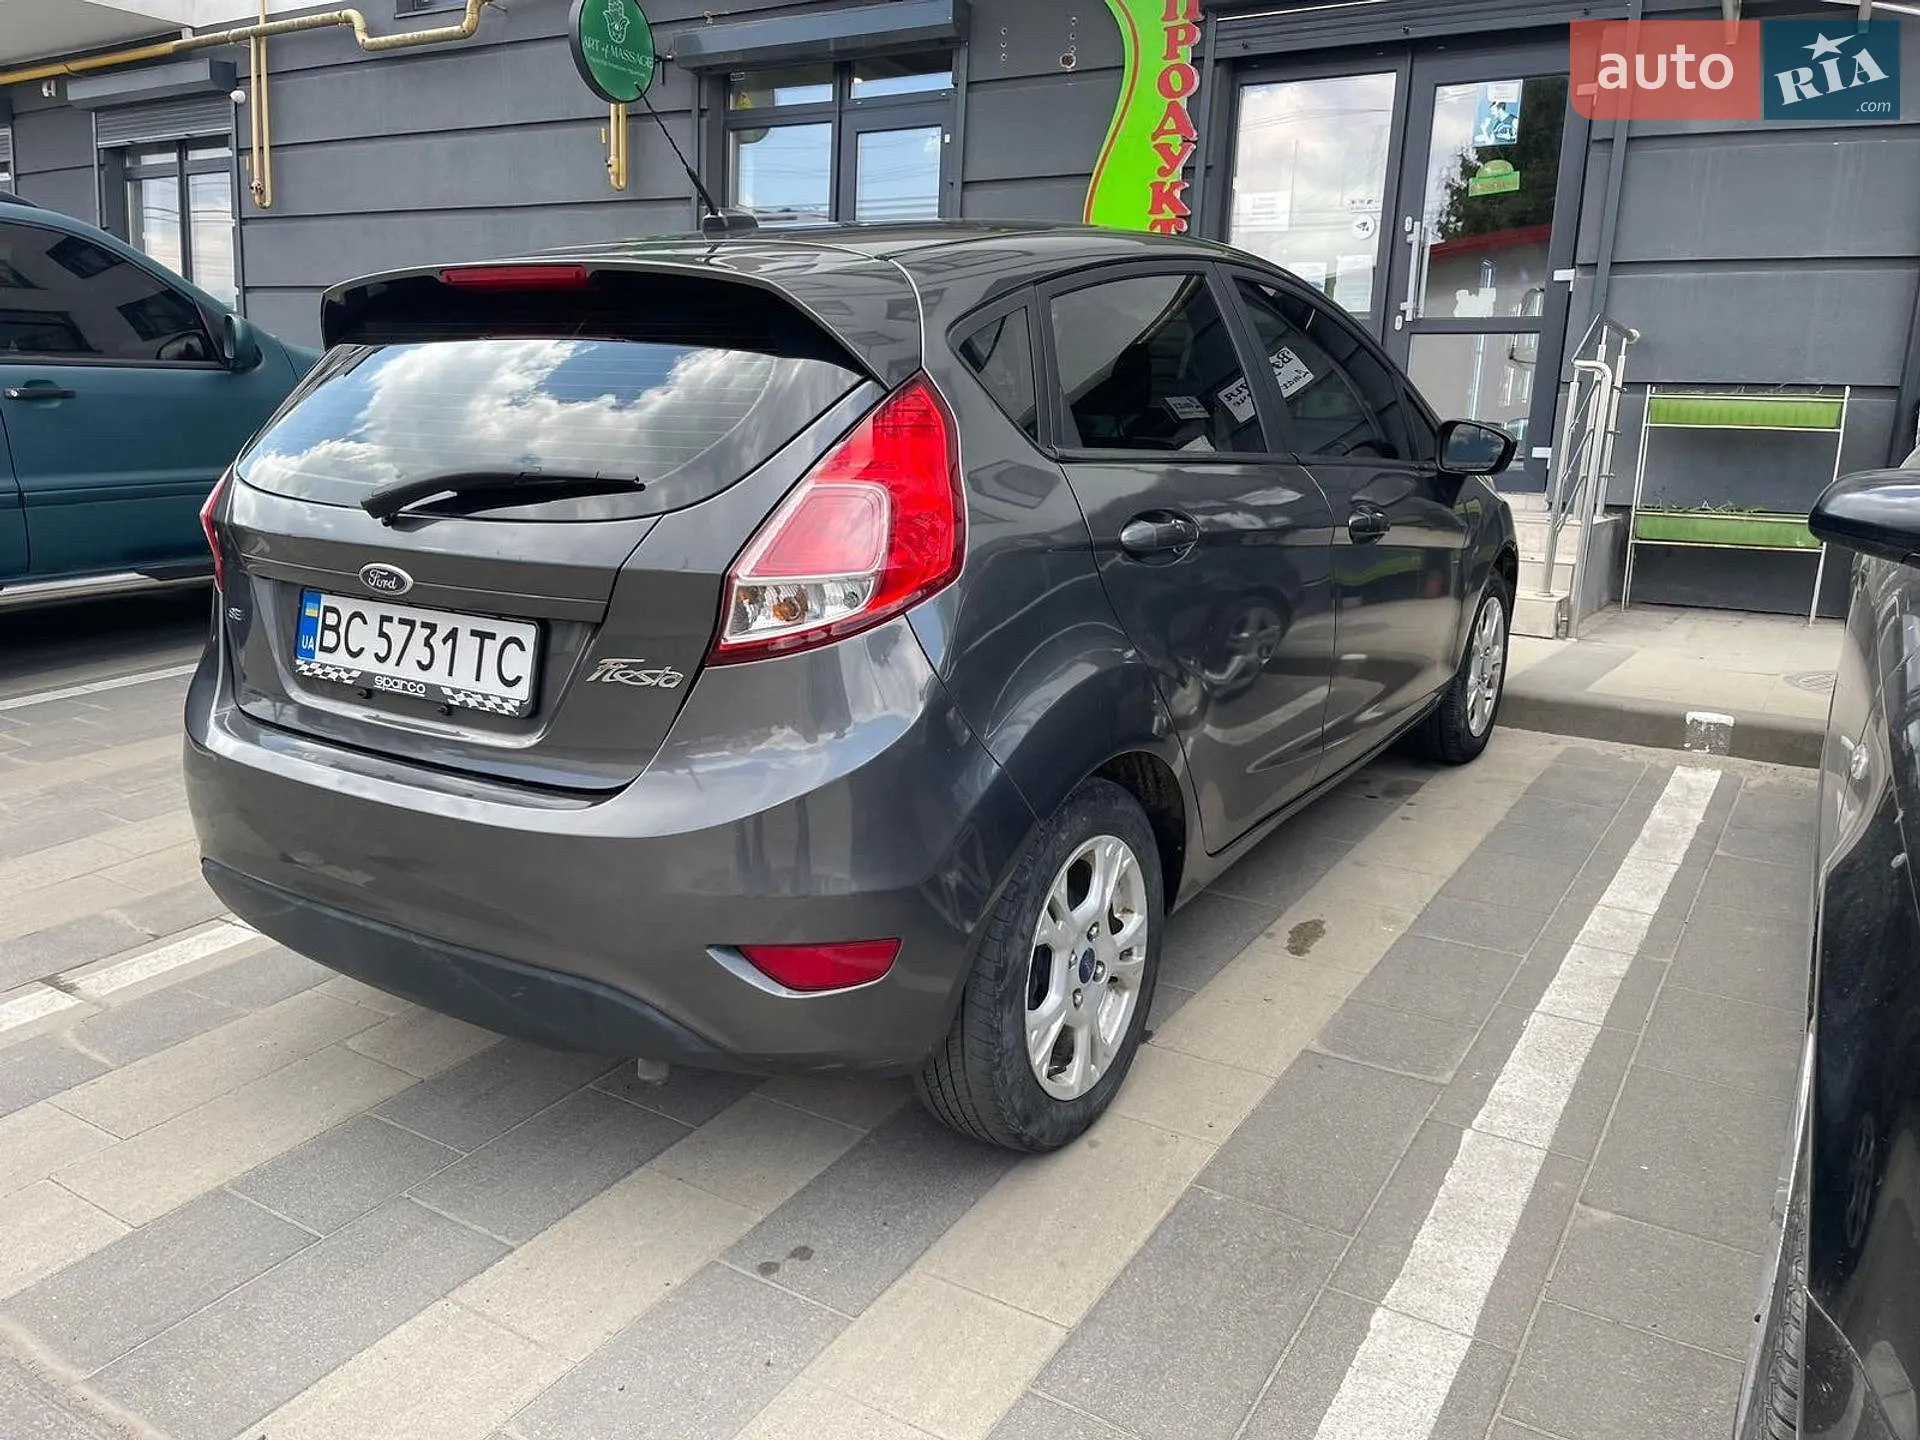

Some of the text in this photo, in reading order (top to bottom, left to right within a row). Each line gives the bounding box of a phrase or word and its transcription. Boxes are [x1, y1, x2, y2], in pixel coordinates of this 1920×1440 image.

[368, 569, 398, 590] Ford
[301, 634, 315, 651] UA
[585, 658, 684, 689] Fiesta
[373, 674, 427, 694] sparco
